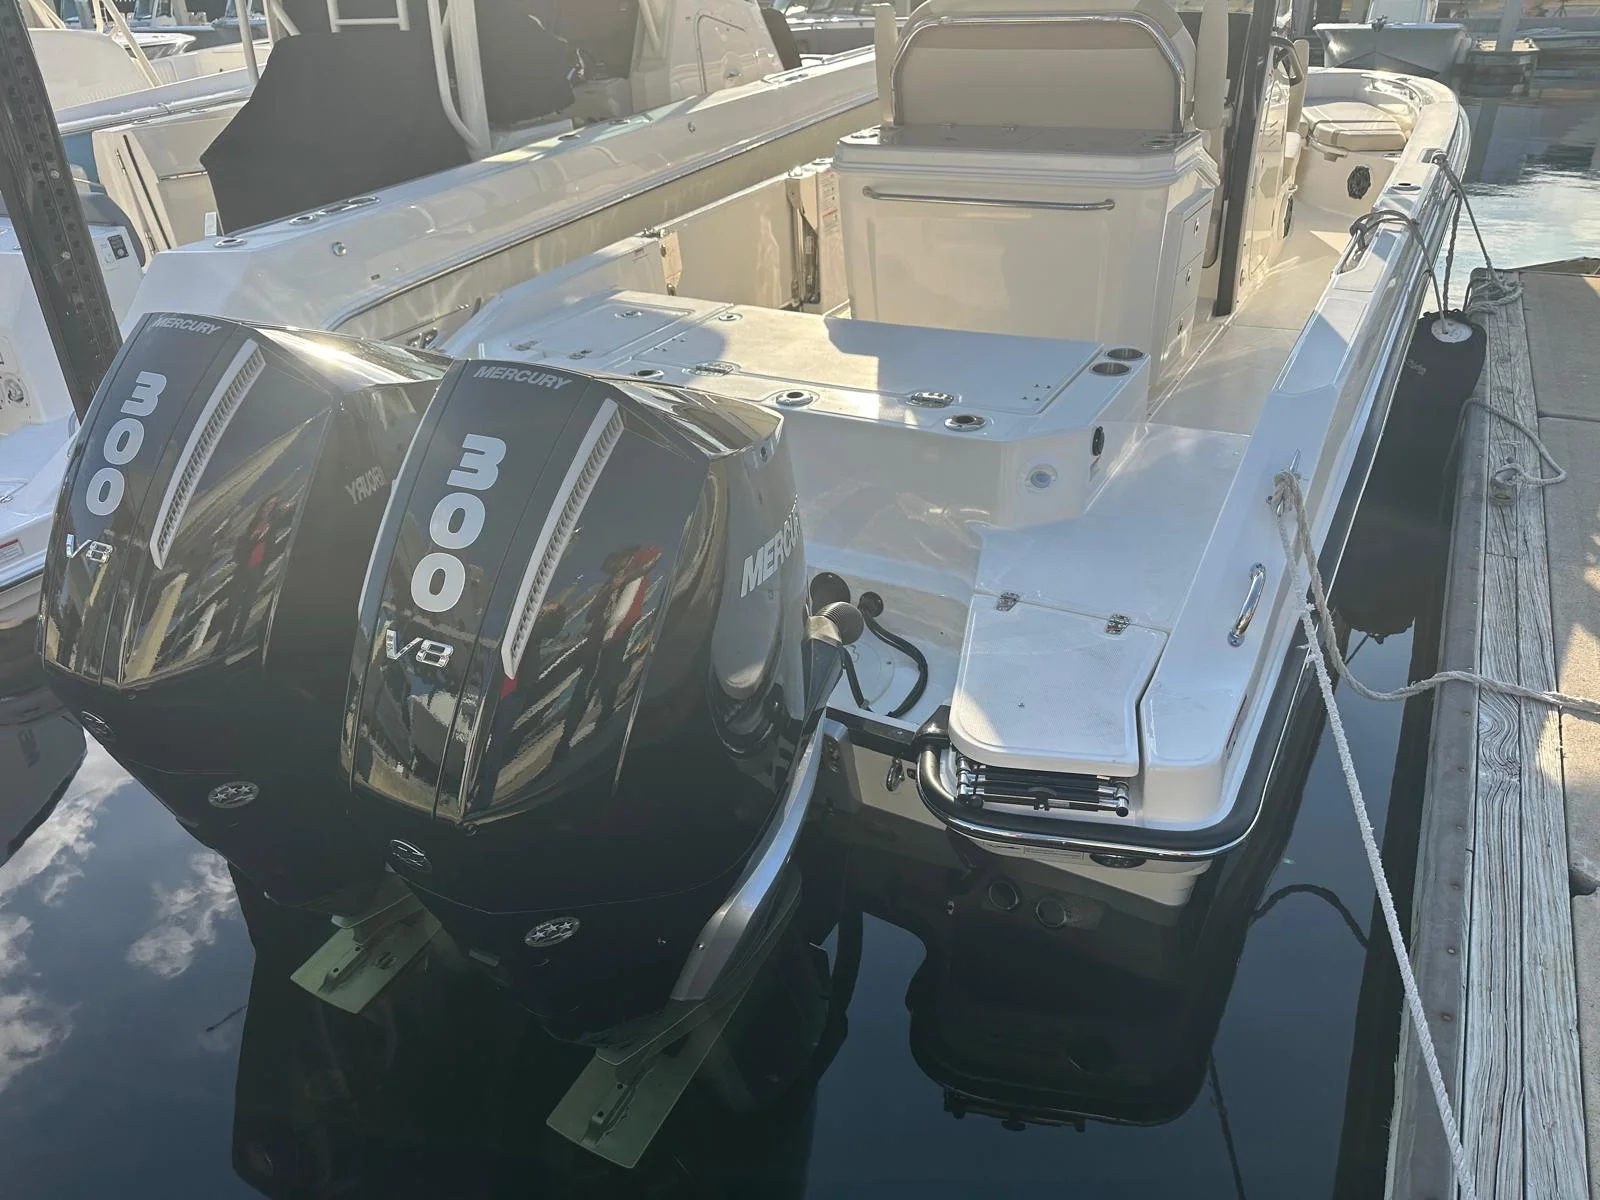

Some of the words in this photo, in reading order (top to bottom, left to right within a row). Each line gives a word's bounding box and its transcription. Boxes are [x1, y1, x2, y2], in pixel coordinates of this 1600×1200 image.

[151, 316, 222, 335] MERCURY
[472, 365, 573, 390] MERCURY
[86, 371, 167, 516] 300
[411, 433, 507, 613] 300
[66, 533, 114, 563] V8
[385, 629, 455, 668] V8
